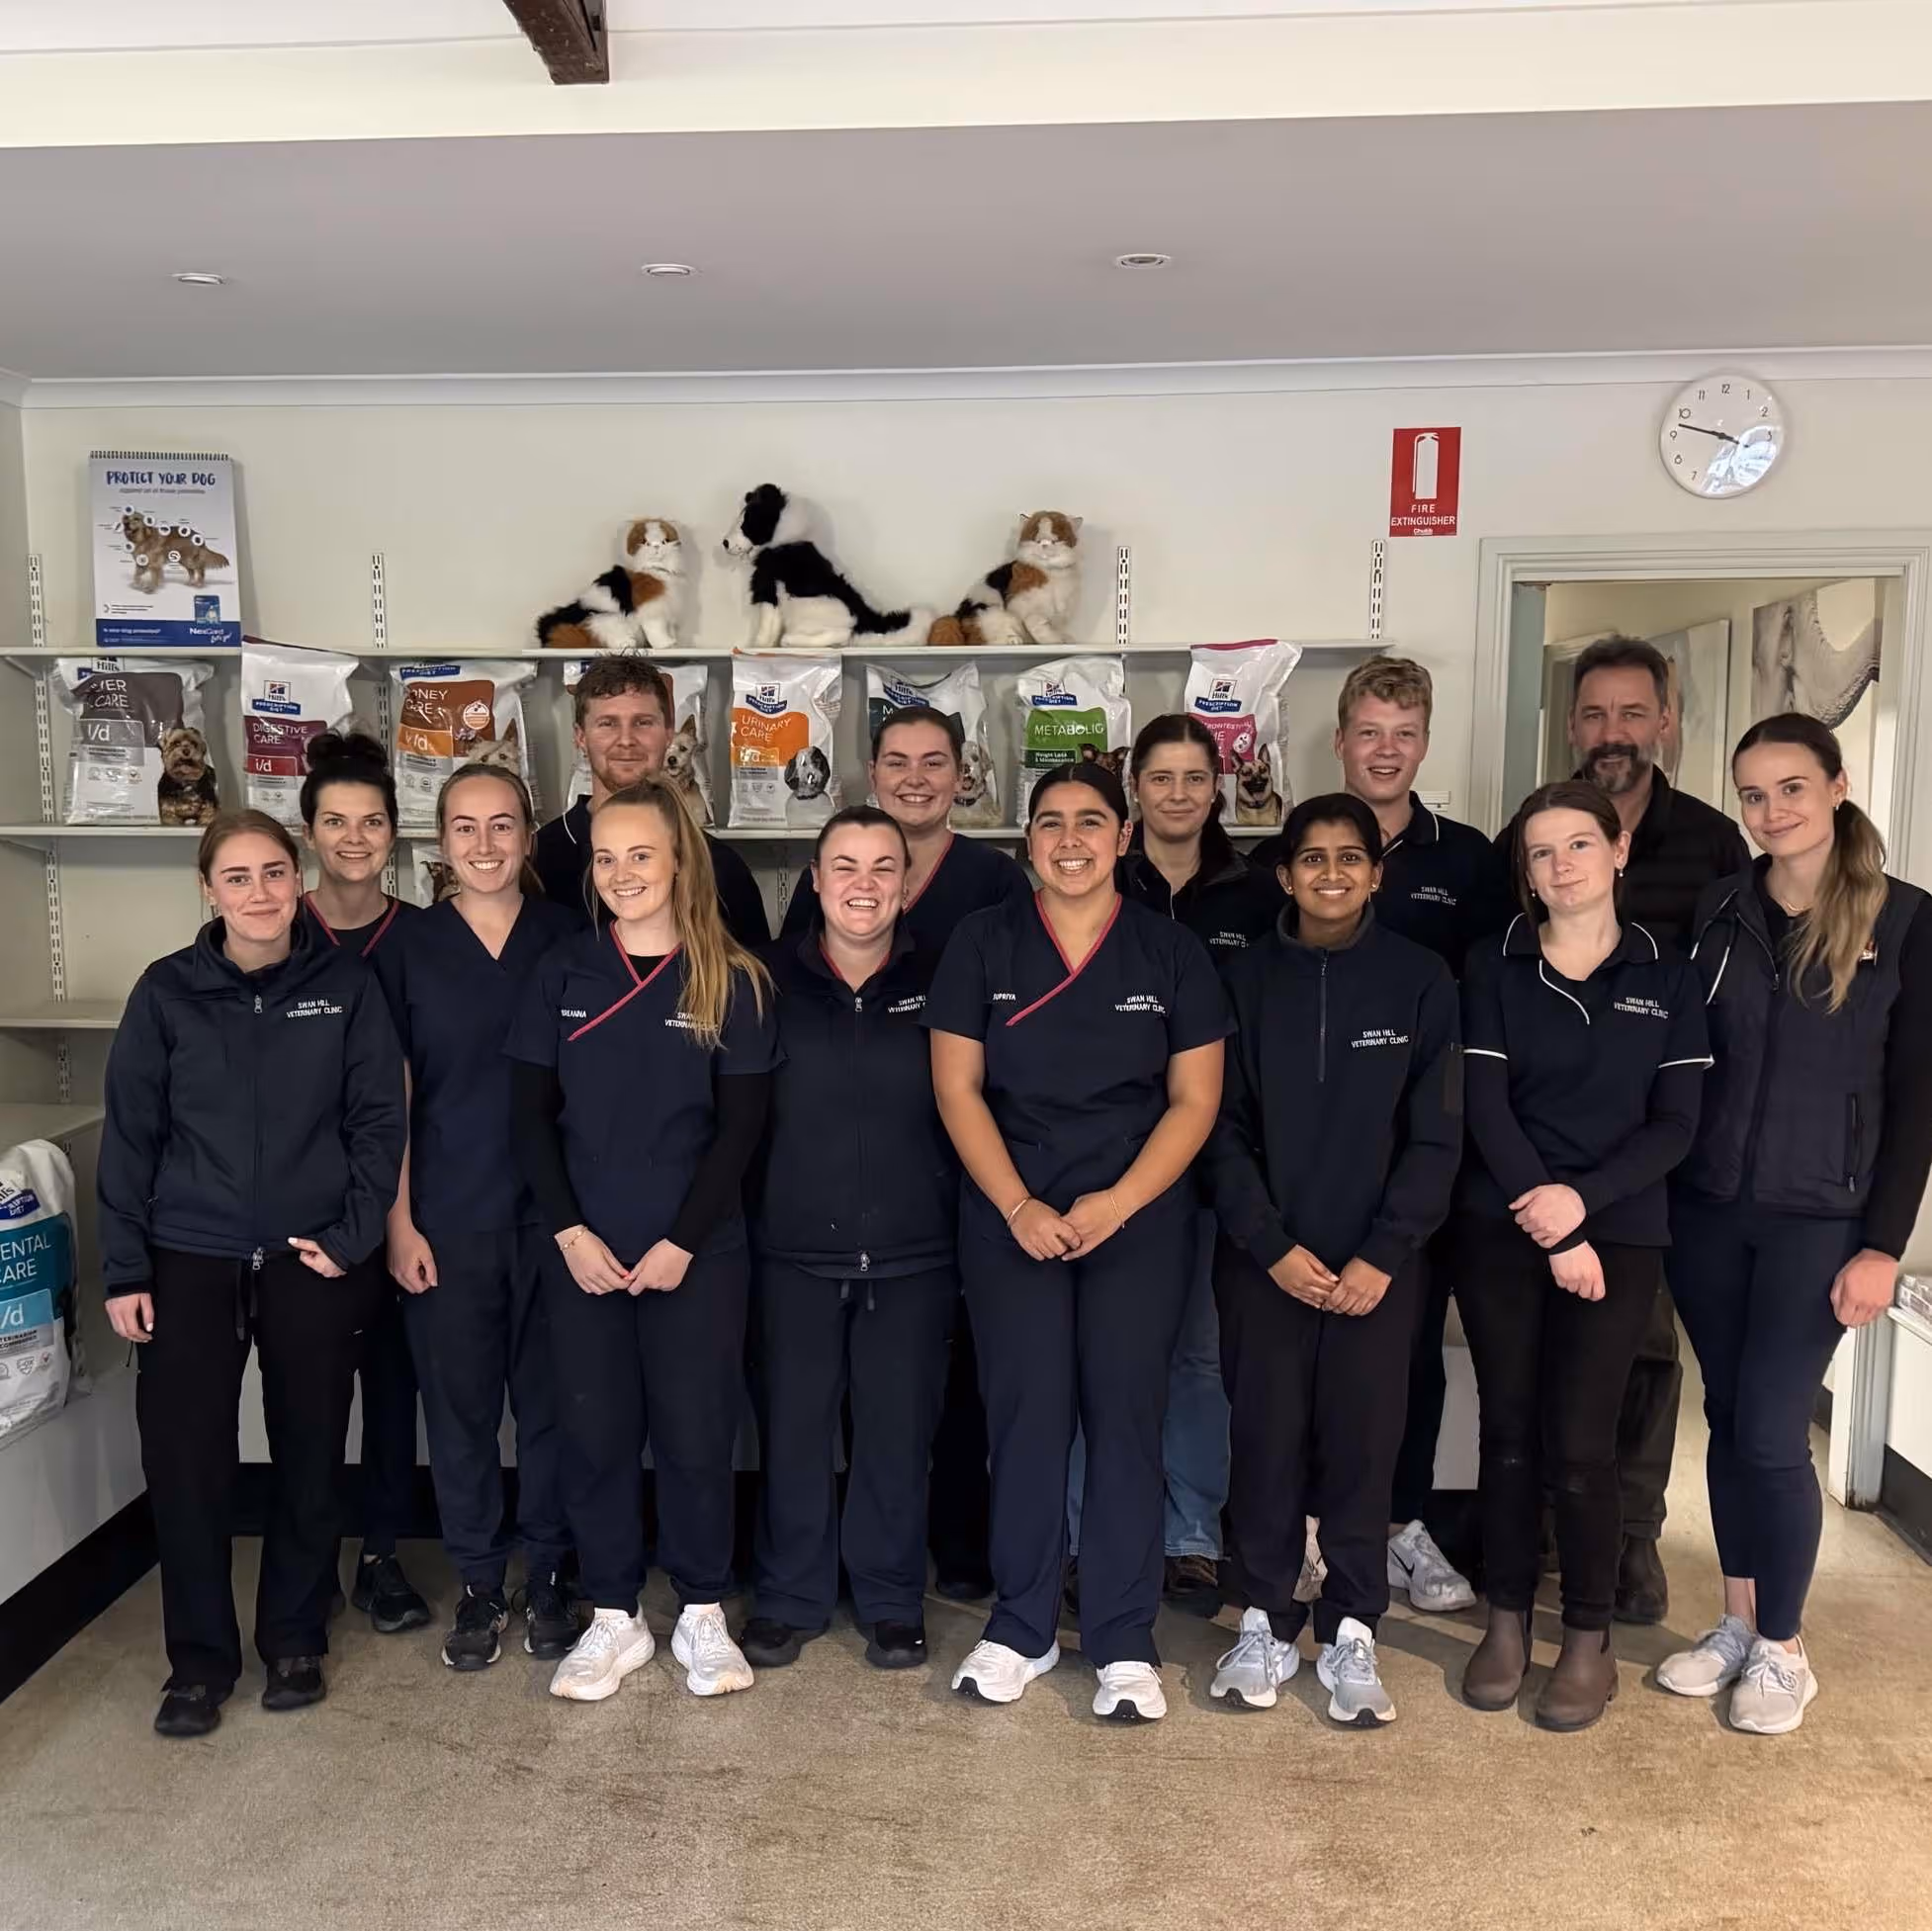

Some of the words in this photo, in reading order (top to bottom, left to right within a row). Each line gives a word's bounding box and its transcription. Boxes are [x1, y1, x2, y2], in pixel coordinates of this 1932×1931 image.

[1698, 390, 1706, 400] 11
[1721, 384, 1730, 395] 12
[1678, 408, 1692, 419] 10
[1761, 406, 1769, 417] 2
[1669, 430, 1678, 441] 9
[106, 471, 154, 485] PROTECT
[158, 473, 188, 485] YOUR
[192, 473, 216, 486] DOG
[1692, 471, 1698, 481] 7
[1411, 504, 1436, 513] FIRE
[1391, 516, 1456, 526] EXTINGUISHER
[95, 693, 130, 707] CARE
[253, 723, 308, 735] DIGESTIVE
[742, 715, 792, 733] URINARY
[253, 734, 283, 745] CARE
[741, 726, 772, 743] CARE
[255, 758, 272, 772] i/d
[1126, 995, 1145, 1004] SWAN
[1625, 997, 1644, 1006] SWAN
[1644, 999, 1659, 1008] HILL
[287, 1008, 322, 1018] VETERINARY
[323, 1006, 342, 1014] CLINIC
[1114, 1003, 1151, 1011] VETERINARY
[1614, 1002, 1649, 1014] VETERINARY
[1650, 1009, 1669, 1019] CLINIC
[1362, 1029, 1381, 1038] SWAN
[1351, 1036, 1387, 1048] VETERINARY
[1389, 1035, 1409, 1045] CLINIC
[0, 1233, 51, 1262] ENTAL
[0, 1259, 38, 1283] ARE
[1, 1302, 24, 1330] /d
